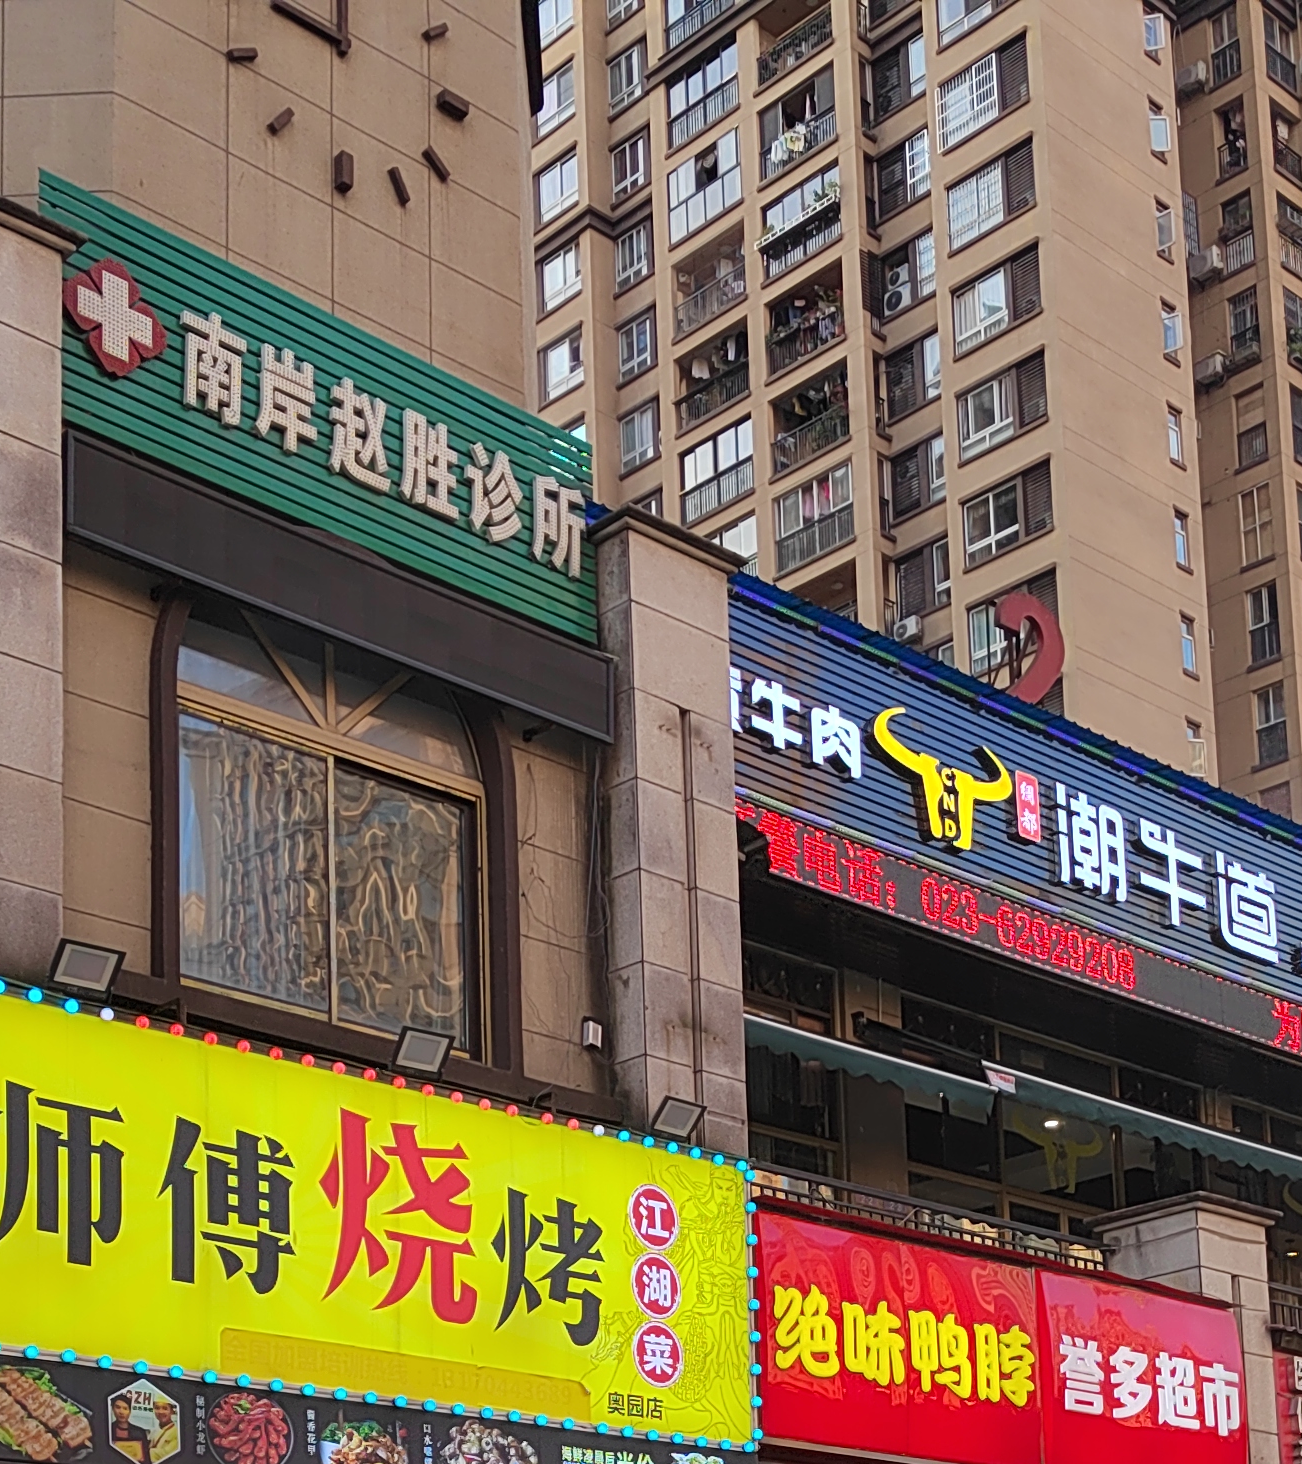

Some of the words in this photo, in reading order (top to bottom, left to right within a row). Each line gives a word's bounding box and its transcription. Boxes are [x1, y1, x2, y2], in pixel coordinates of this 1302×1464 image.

[179, 310, 589, 582] 南岸赵胜诊所
[1055, 782, 1280, 965] 潮牛道
[636, 1195, 678, 1375] 江湖菜
[773, 1283, 1036, 1407] 绝味鸭脖
[607, 1391, 664, 1421] 奥园店
[1059, 1334, 1240, 1437] 誉多超市
